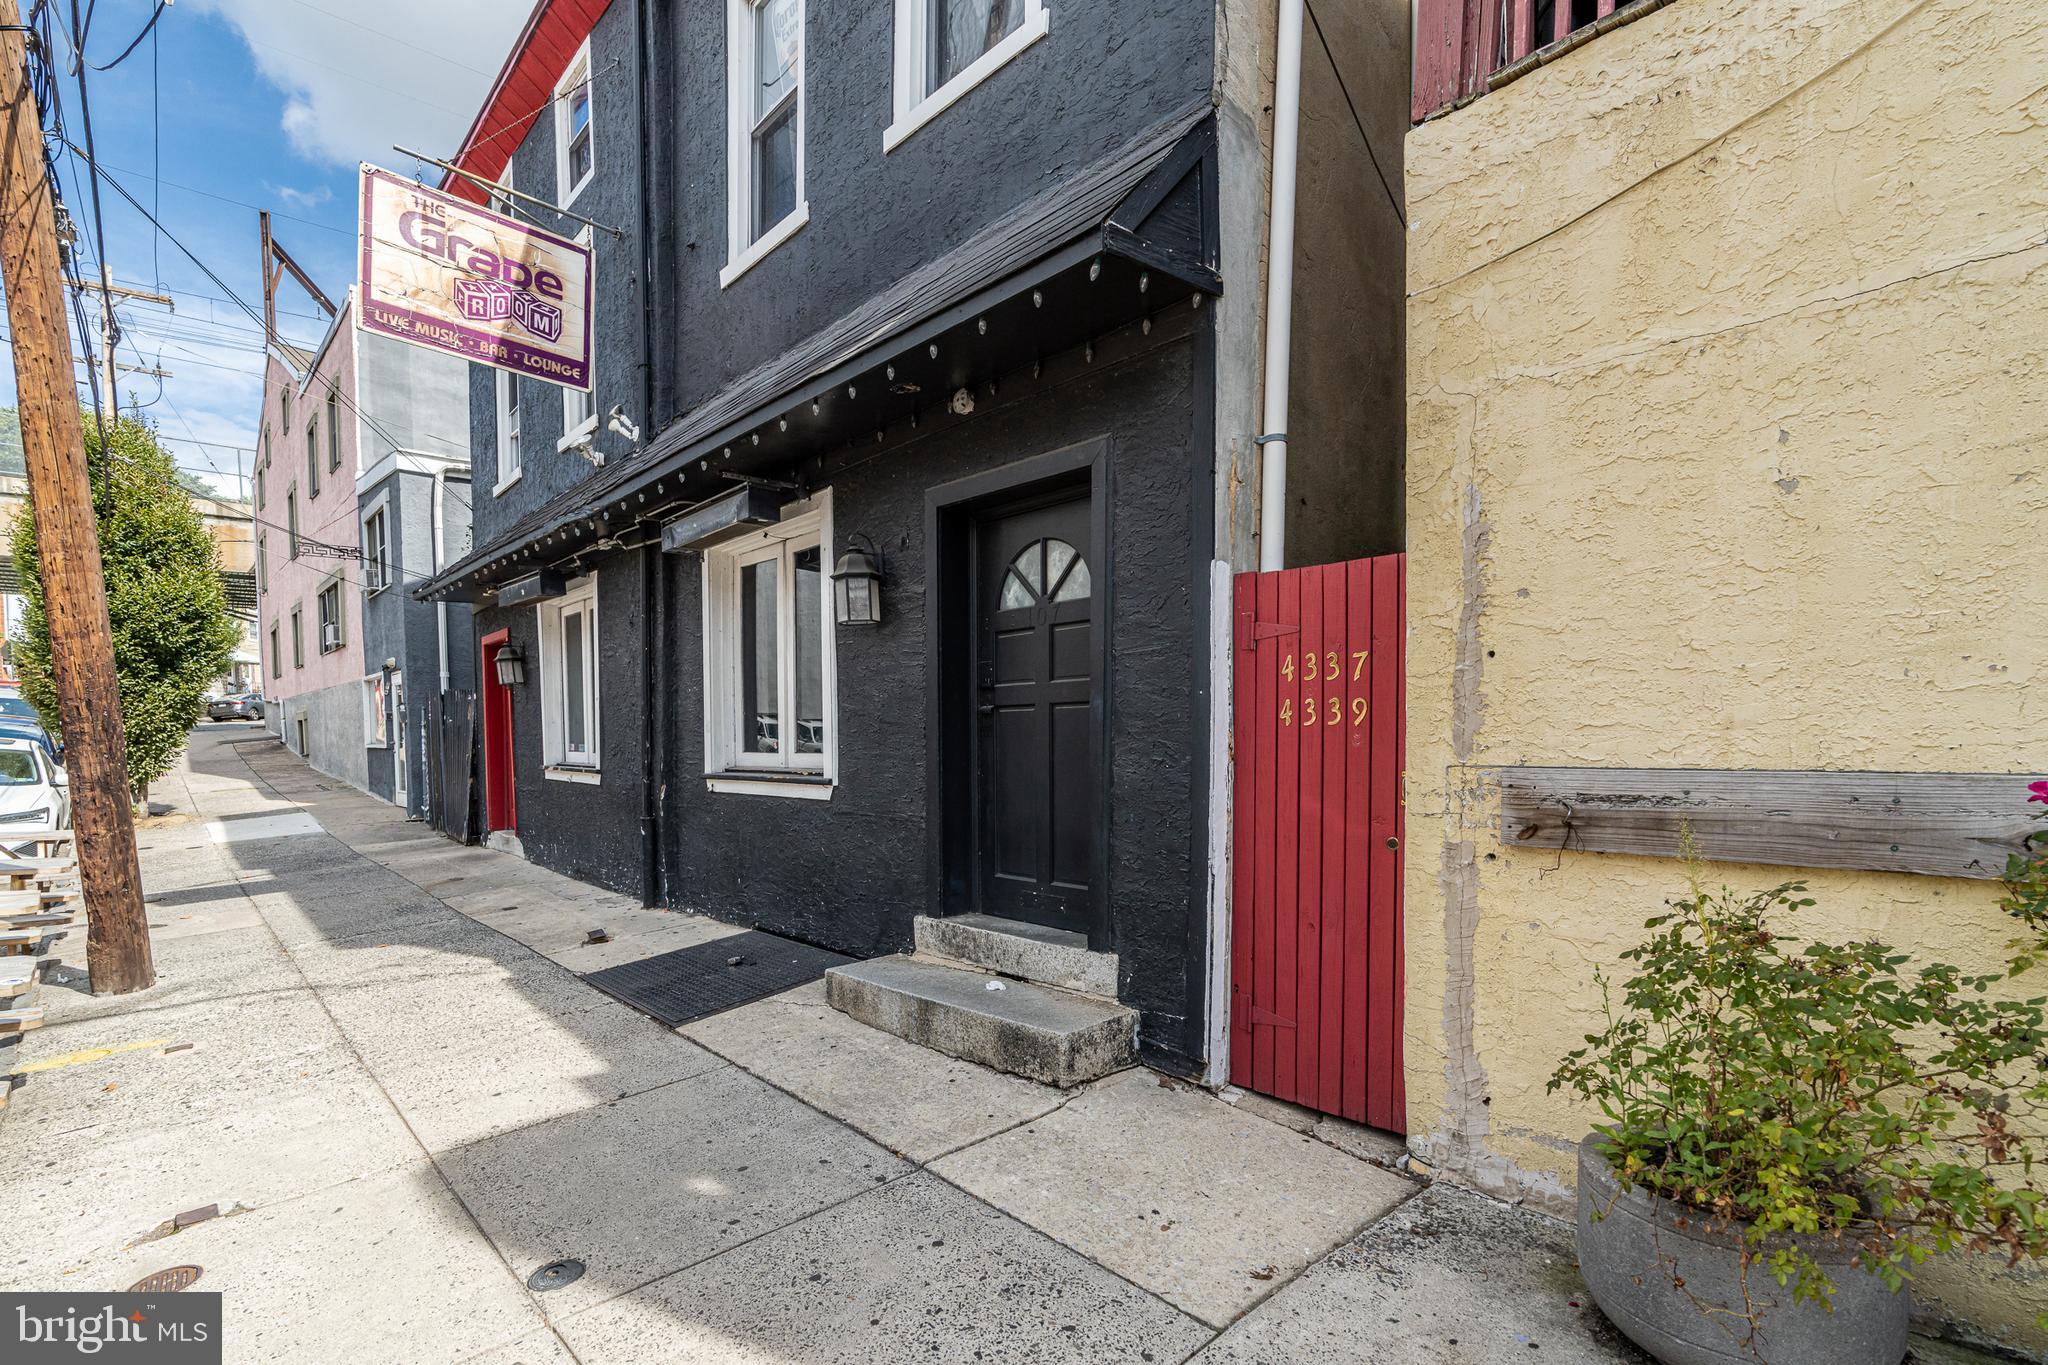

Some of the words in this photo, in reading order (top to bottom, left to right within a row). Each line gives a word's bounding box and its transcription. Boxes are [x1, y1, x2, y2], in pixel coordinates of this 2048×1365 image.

[411, 195, 446, 218] THE
[374, 309, 410, 330] LIVE
[480, 341, 508, 359] BAR
[523, 353, 581, 380] LOUNGE
[1281, 650, 1369, 682] 4337
[1279, 697, 1368, 727] 4339
